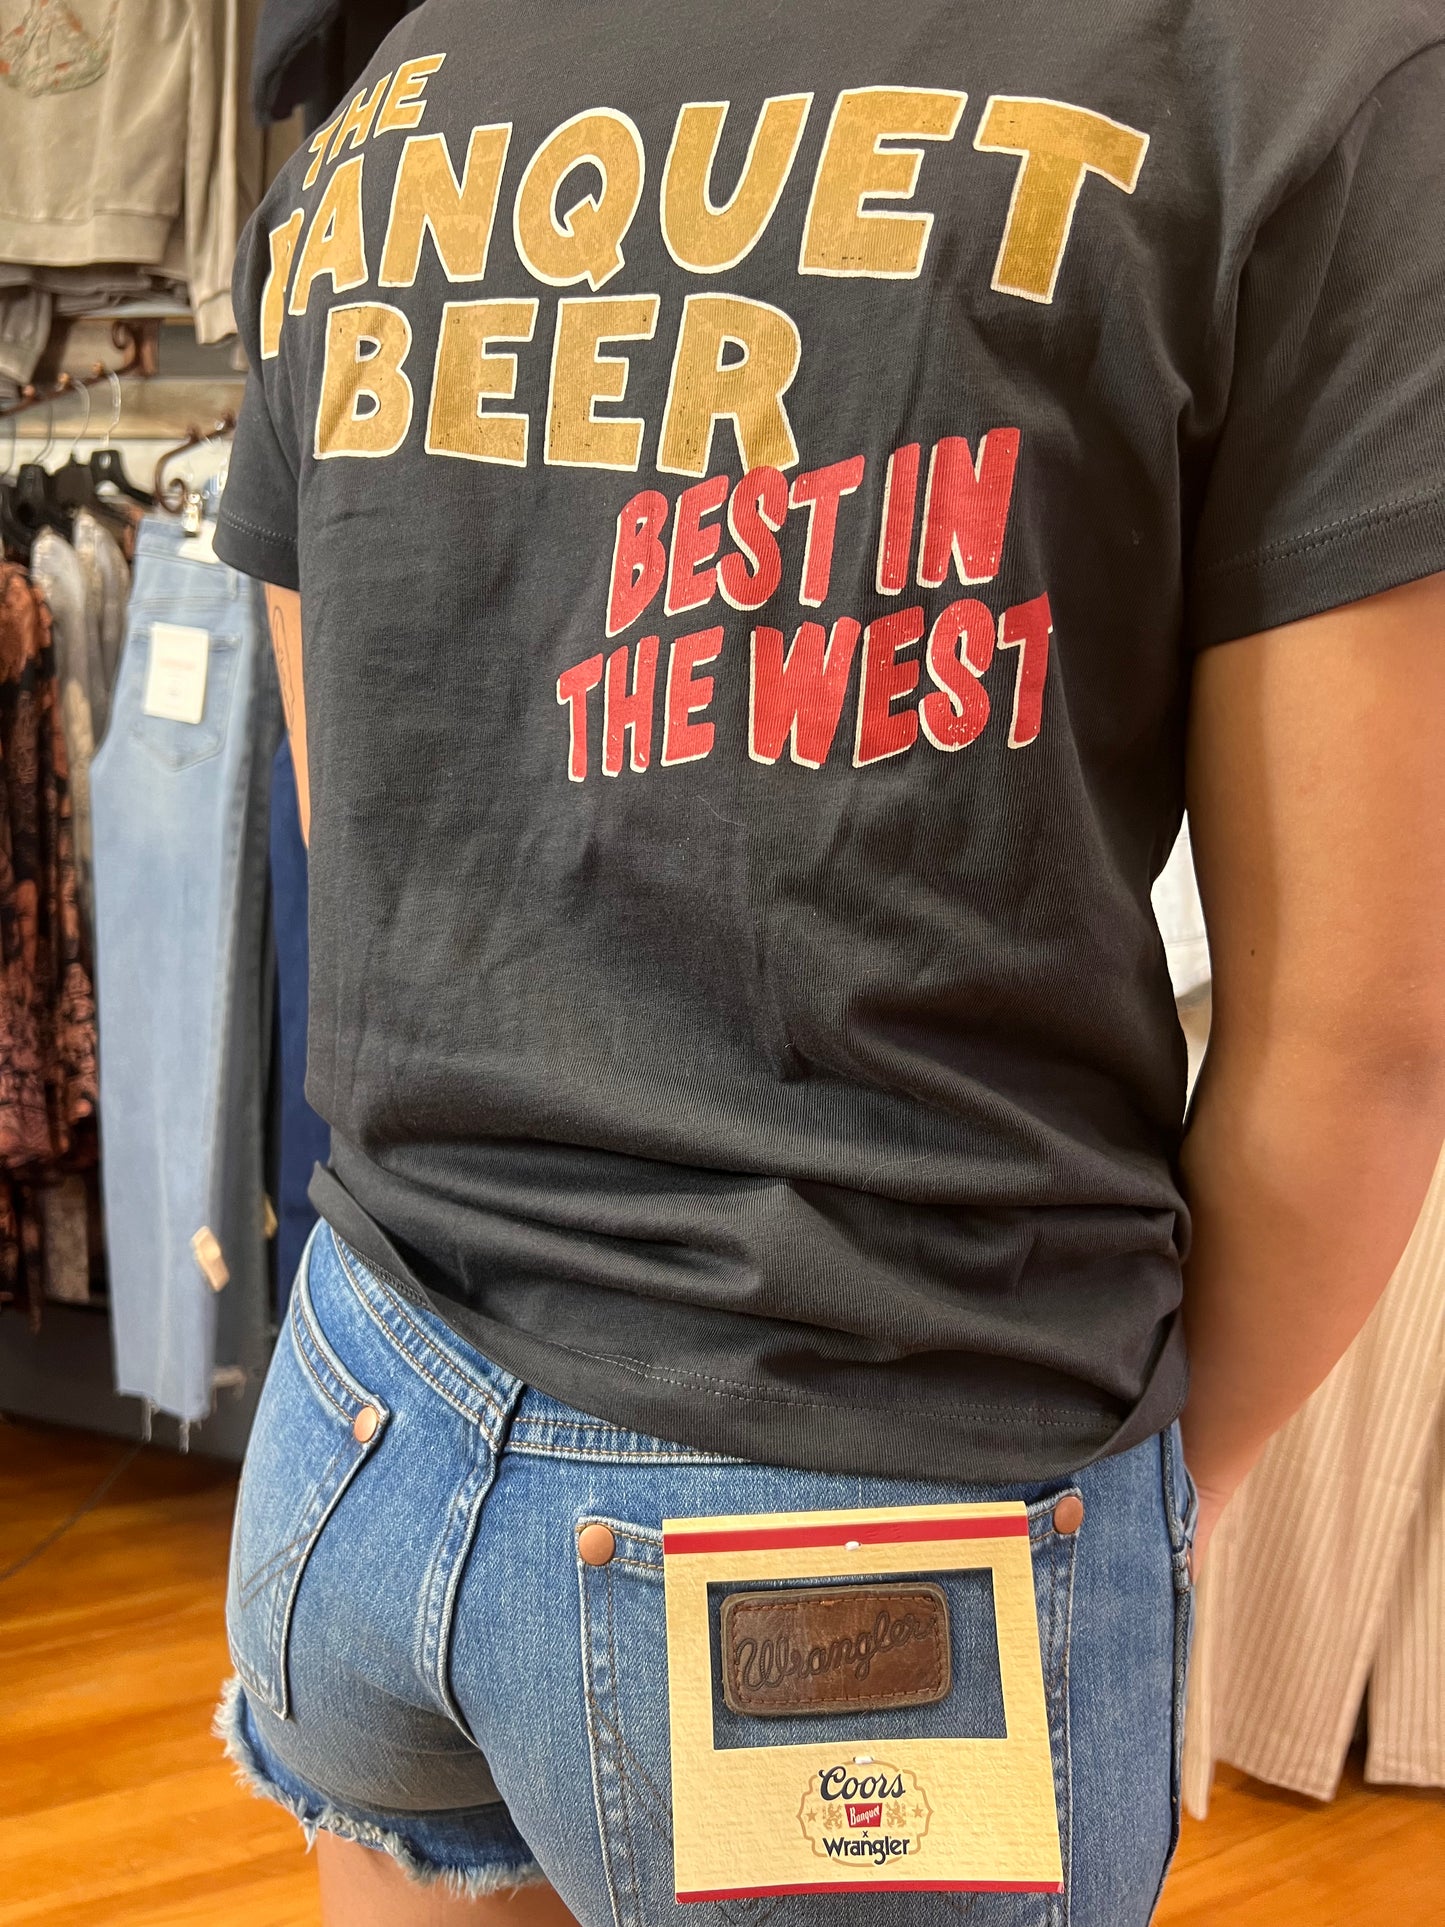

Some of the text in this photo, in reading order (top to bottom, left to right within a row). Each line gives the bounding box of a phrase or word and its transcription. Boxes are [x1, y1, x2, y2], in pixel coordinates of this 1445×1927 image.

[302, 53, 446, 190] THE
[313, 293, 801, 478] BEER
[606, 427, 1020, 638] BEST IN
[557, 591, 1054, 783] THE WEST
[735, 1610, 936, 1691] Wrangler
[818, 1765, 906, 1801] Coors
[822, 1835, 910, 1865] Wrangler
